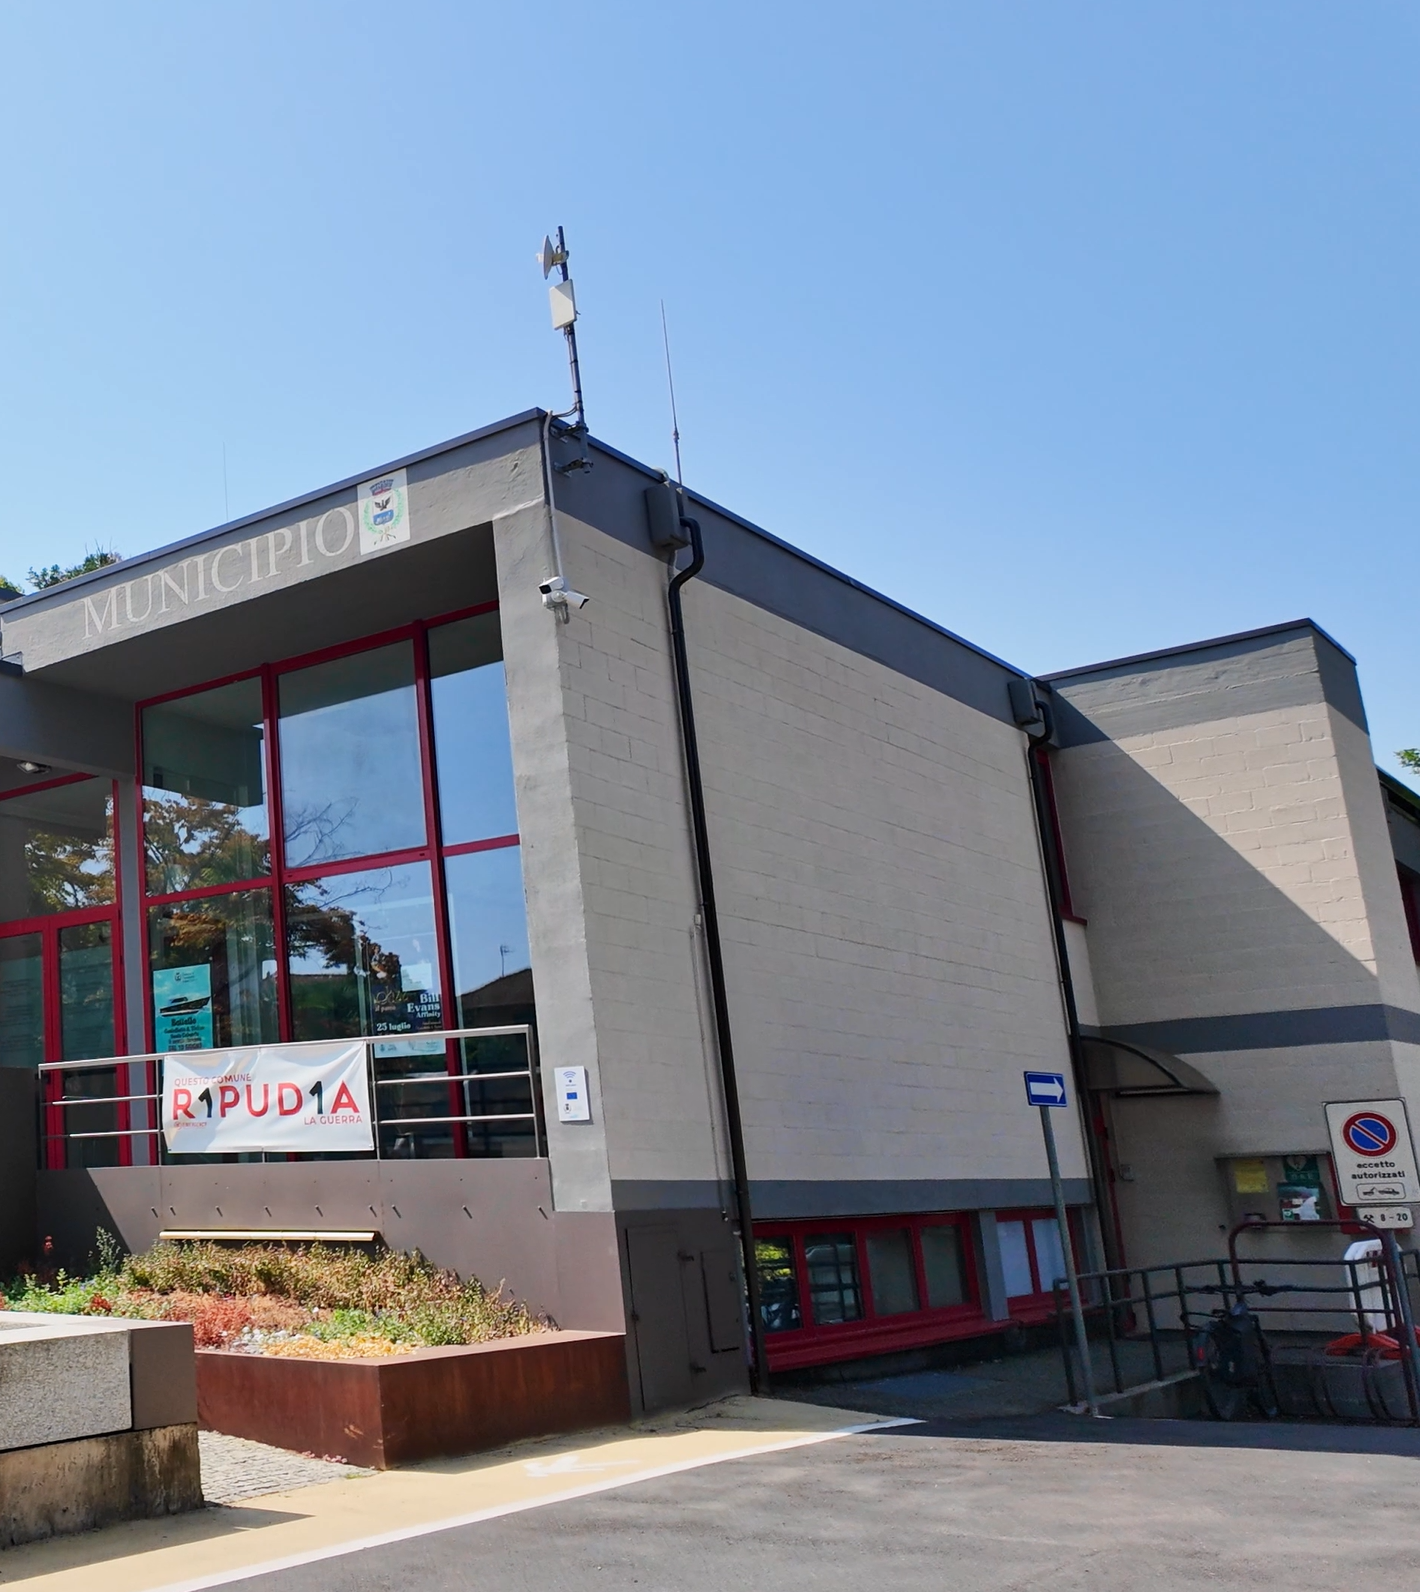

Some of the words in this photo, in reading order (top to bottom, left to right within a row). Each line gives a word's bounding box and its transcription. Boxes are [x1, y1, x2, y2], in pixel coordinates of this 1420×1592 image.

[82, 507, 355, 639] MUNICIPIO
[420, 993, 440, 1003] Bill
[407, 1002, 440, 1013] Evans
[376, 1022, 387, 1031] 25
[389, 1022, 411, 1031] luglio
[174, 1077, 209, 1086] QUESTO
[212, 1073, 252, 1084] COMUNE
[173, 1080, 360, 1120] R1PUD1A
[304, 1116, 316, 1126] LA
[320, 1114, 363, 1125] GUERRA
[1356, 1161, 1396, 1169] eccetto
[1351, 1171, 1406, 1179] autorizzati
[1380, 1213, 1386, 1222] 8
[1396, 1213, 1408, 1221] 20
